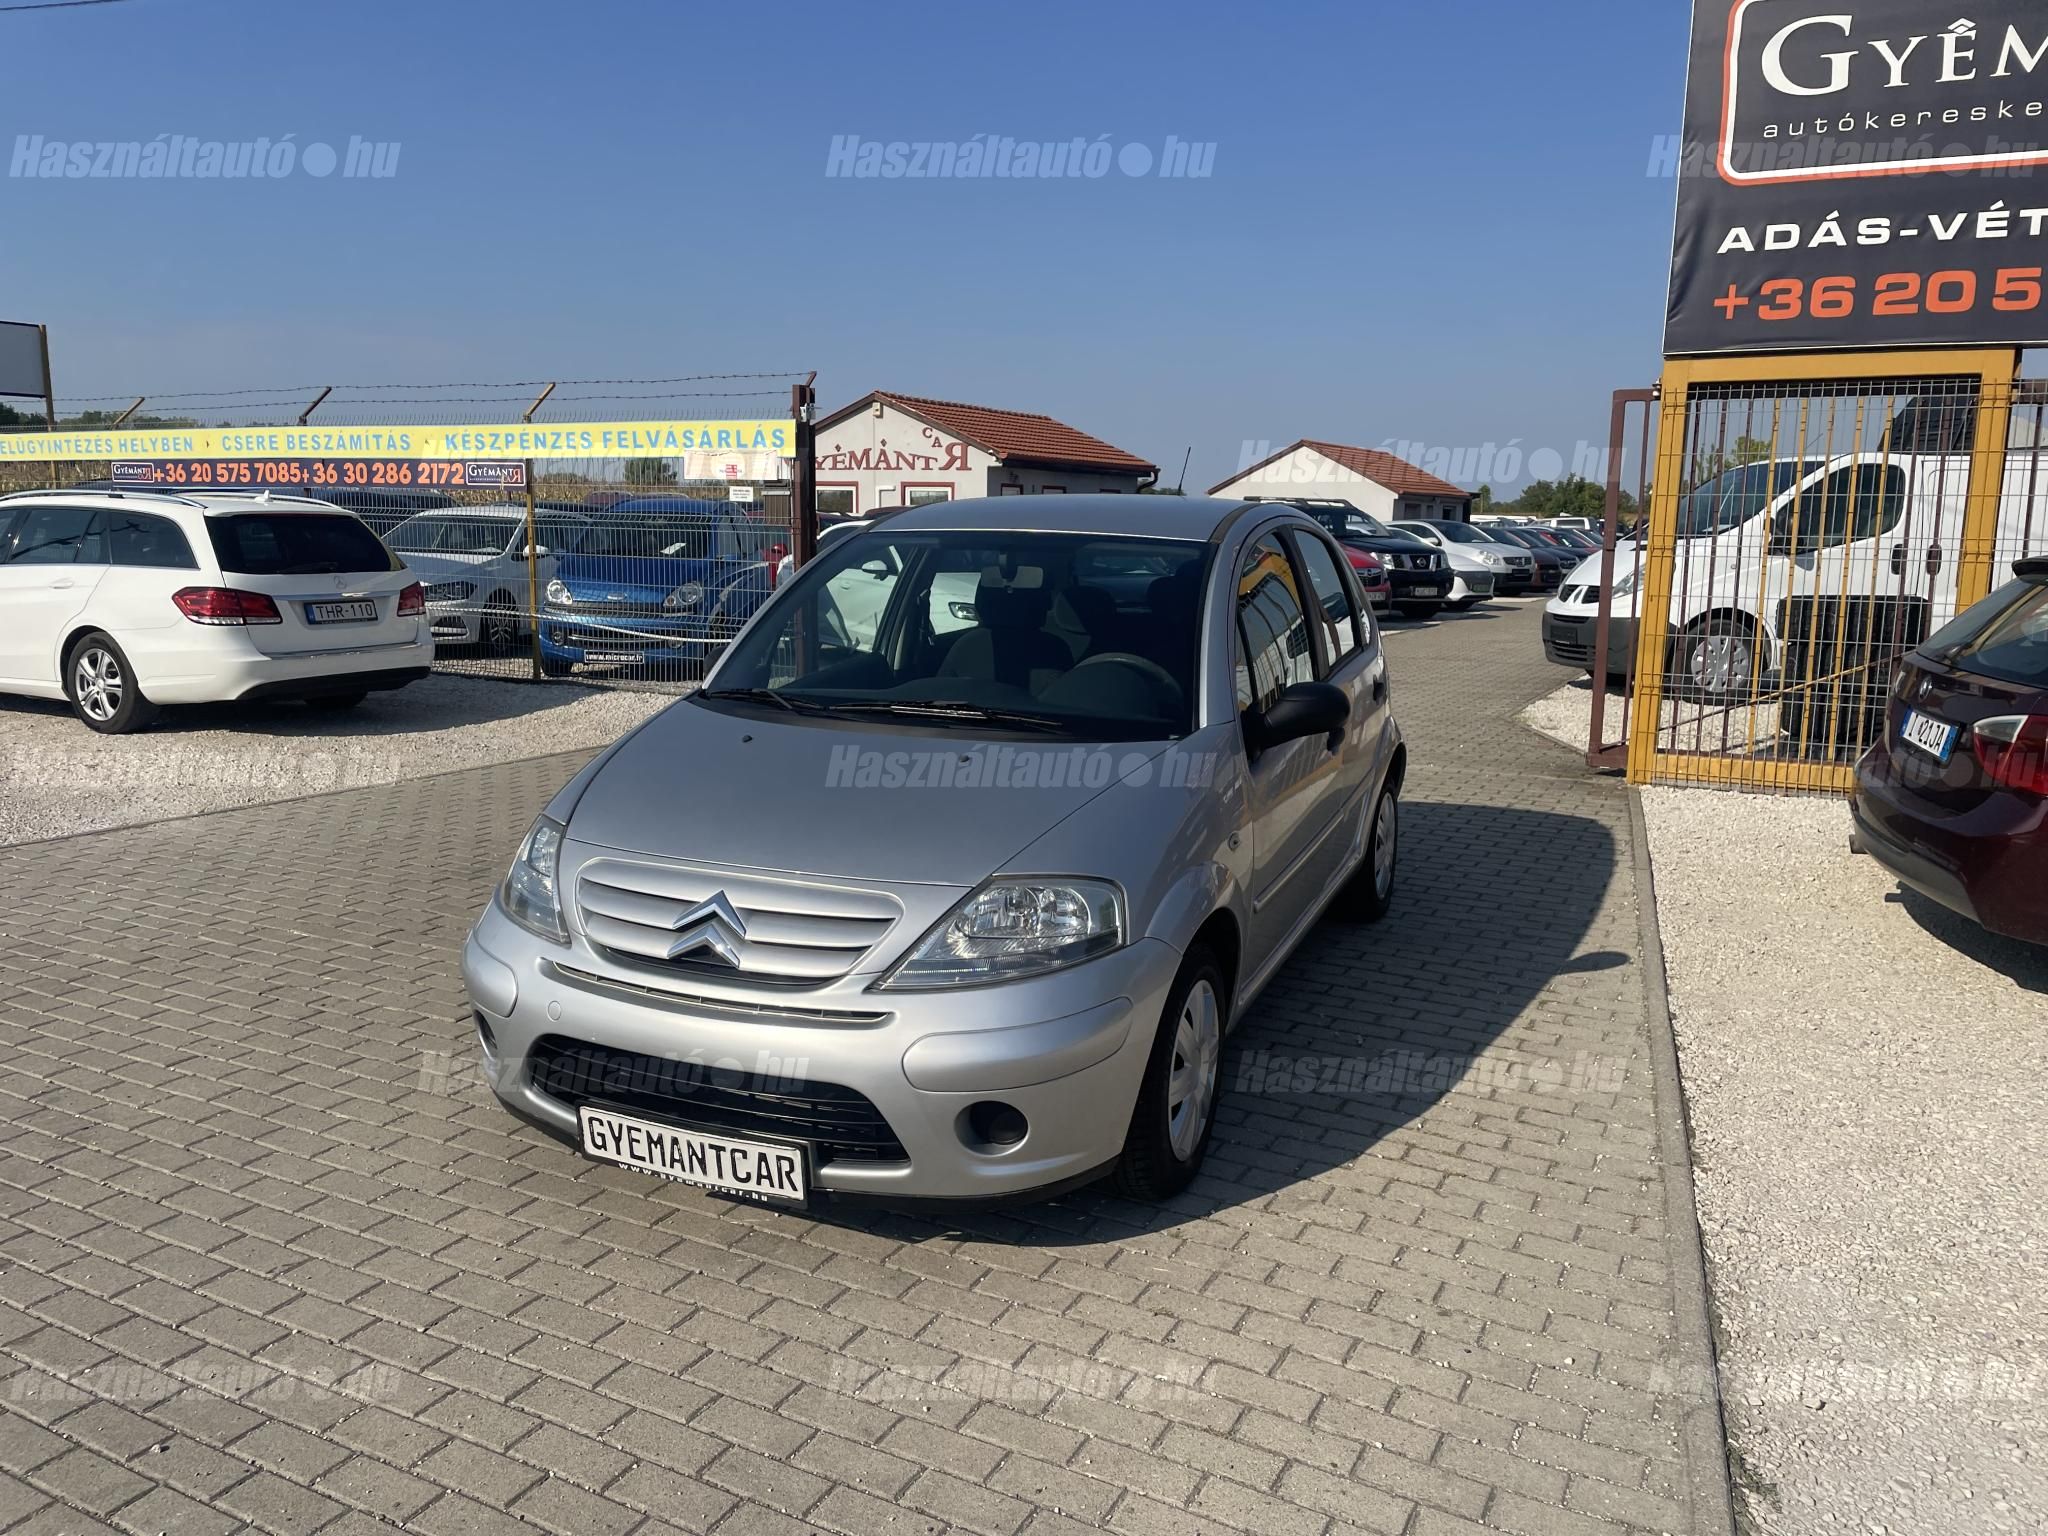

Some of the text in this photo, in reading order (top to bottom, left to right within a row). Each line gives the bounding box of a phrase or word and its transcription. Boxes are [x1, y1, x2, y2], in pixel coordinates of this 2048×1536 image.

[1763, 99, 2043, 138] autókereske
[1713, 266, 2043, 321] +36 20 5
[118, 436, 193, 453] HELYBEN
[222, 434, 279, 451] CSERE
[286, 430, 411, 451] BESZÁMÍTÁS
[445, 428, 593, 450] KÉSZPÉNZES
[602, 424, 785, 449] FELVÁSÁRLÁS
[191, 463, 212, 483] 20
[216, 463, 251, 483] 575
[343, 462, 368, 484] 30
[372, 462, 412, 485] 286
[417, 462, 465, 485] 2172
[315, 603, 373, 619] THR-110
[588, 1115, 799, 1192] GYEMANTCAR
